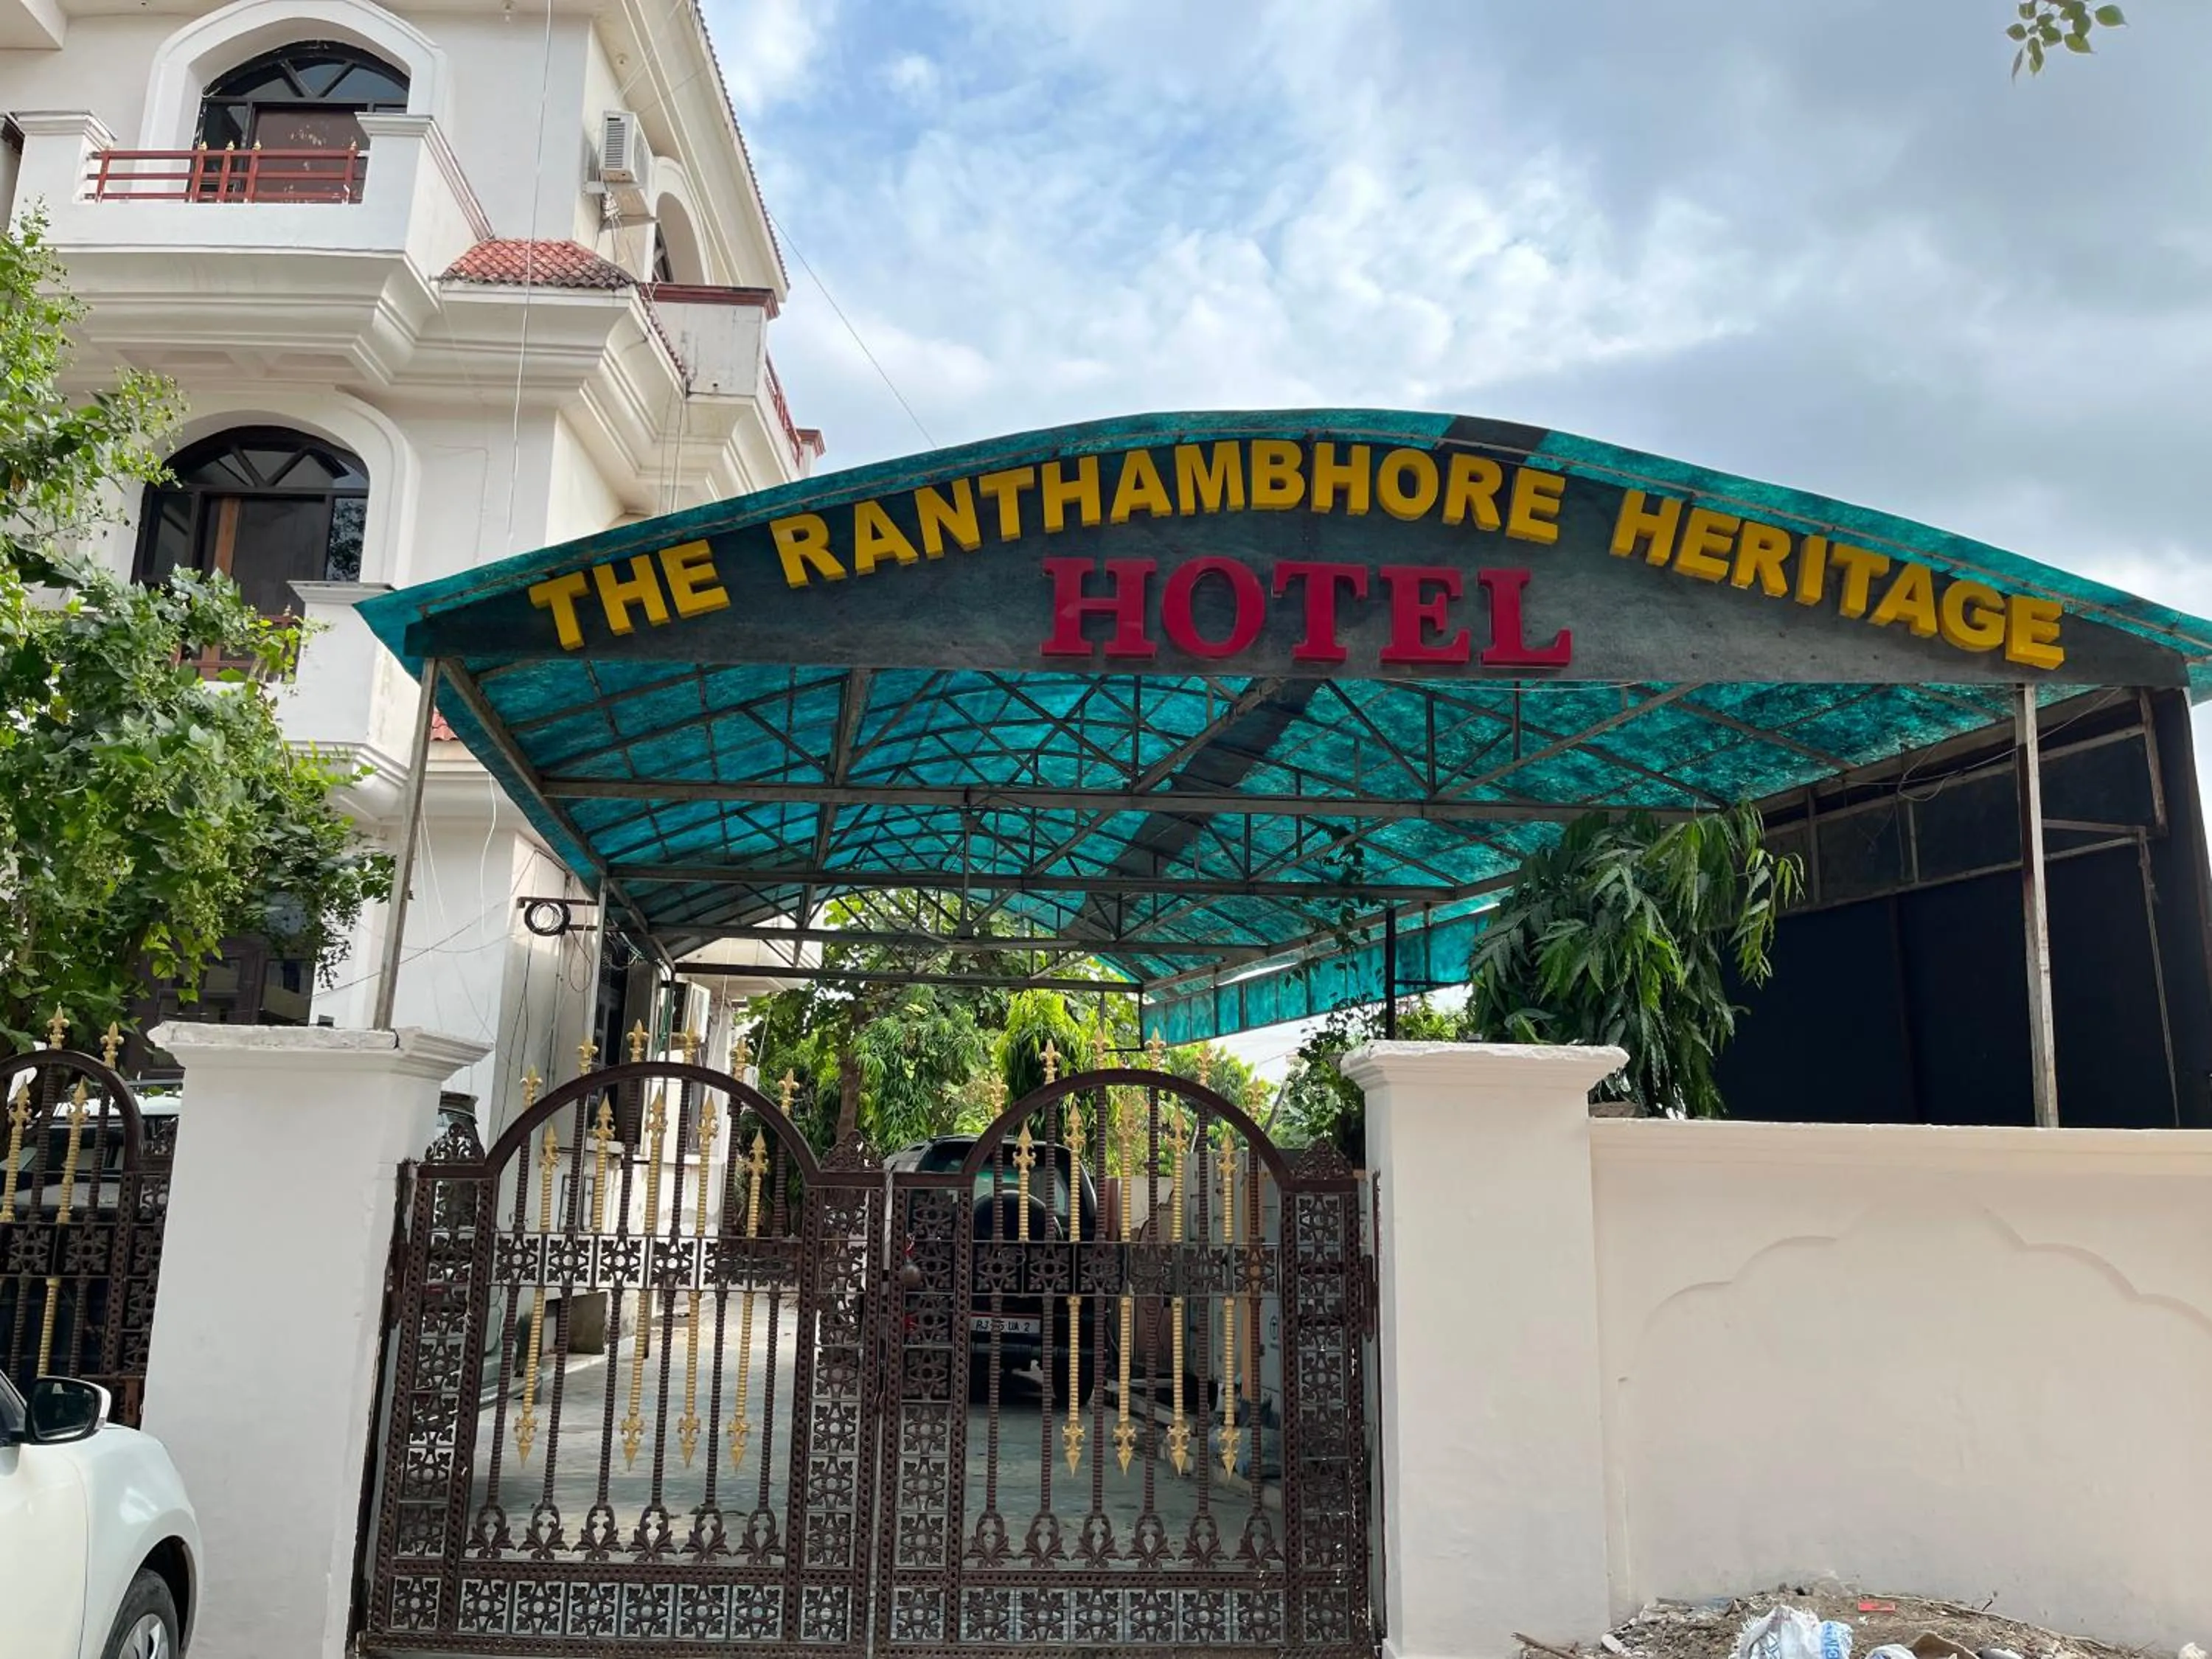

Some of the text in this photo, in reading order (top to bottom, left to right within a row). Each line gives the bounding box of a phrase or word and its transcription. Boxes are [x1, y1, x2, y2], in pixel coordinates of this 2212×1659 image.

[528, 440, 2065, 669] THE RANTHAMBHORE HERITAGE
[1040, 556, 1572, 667] HOTEL
